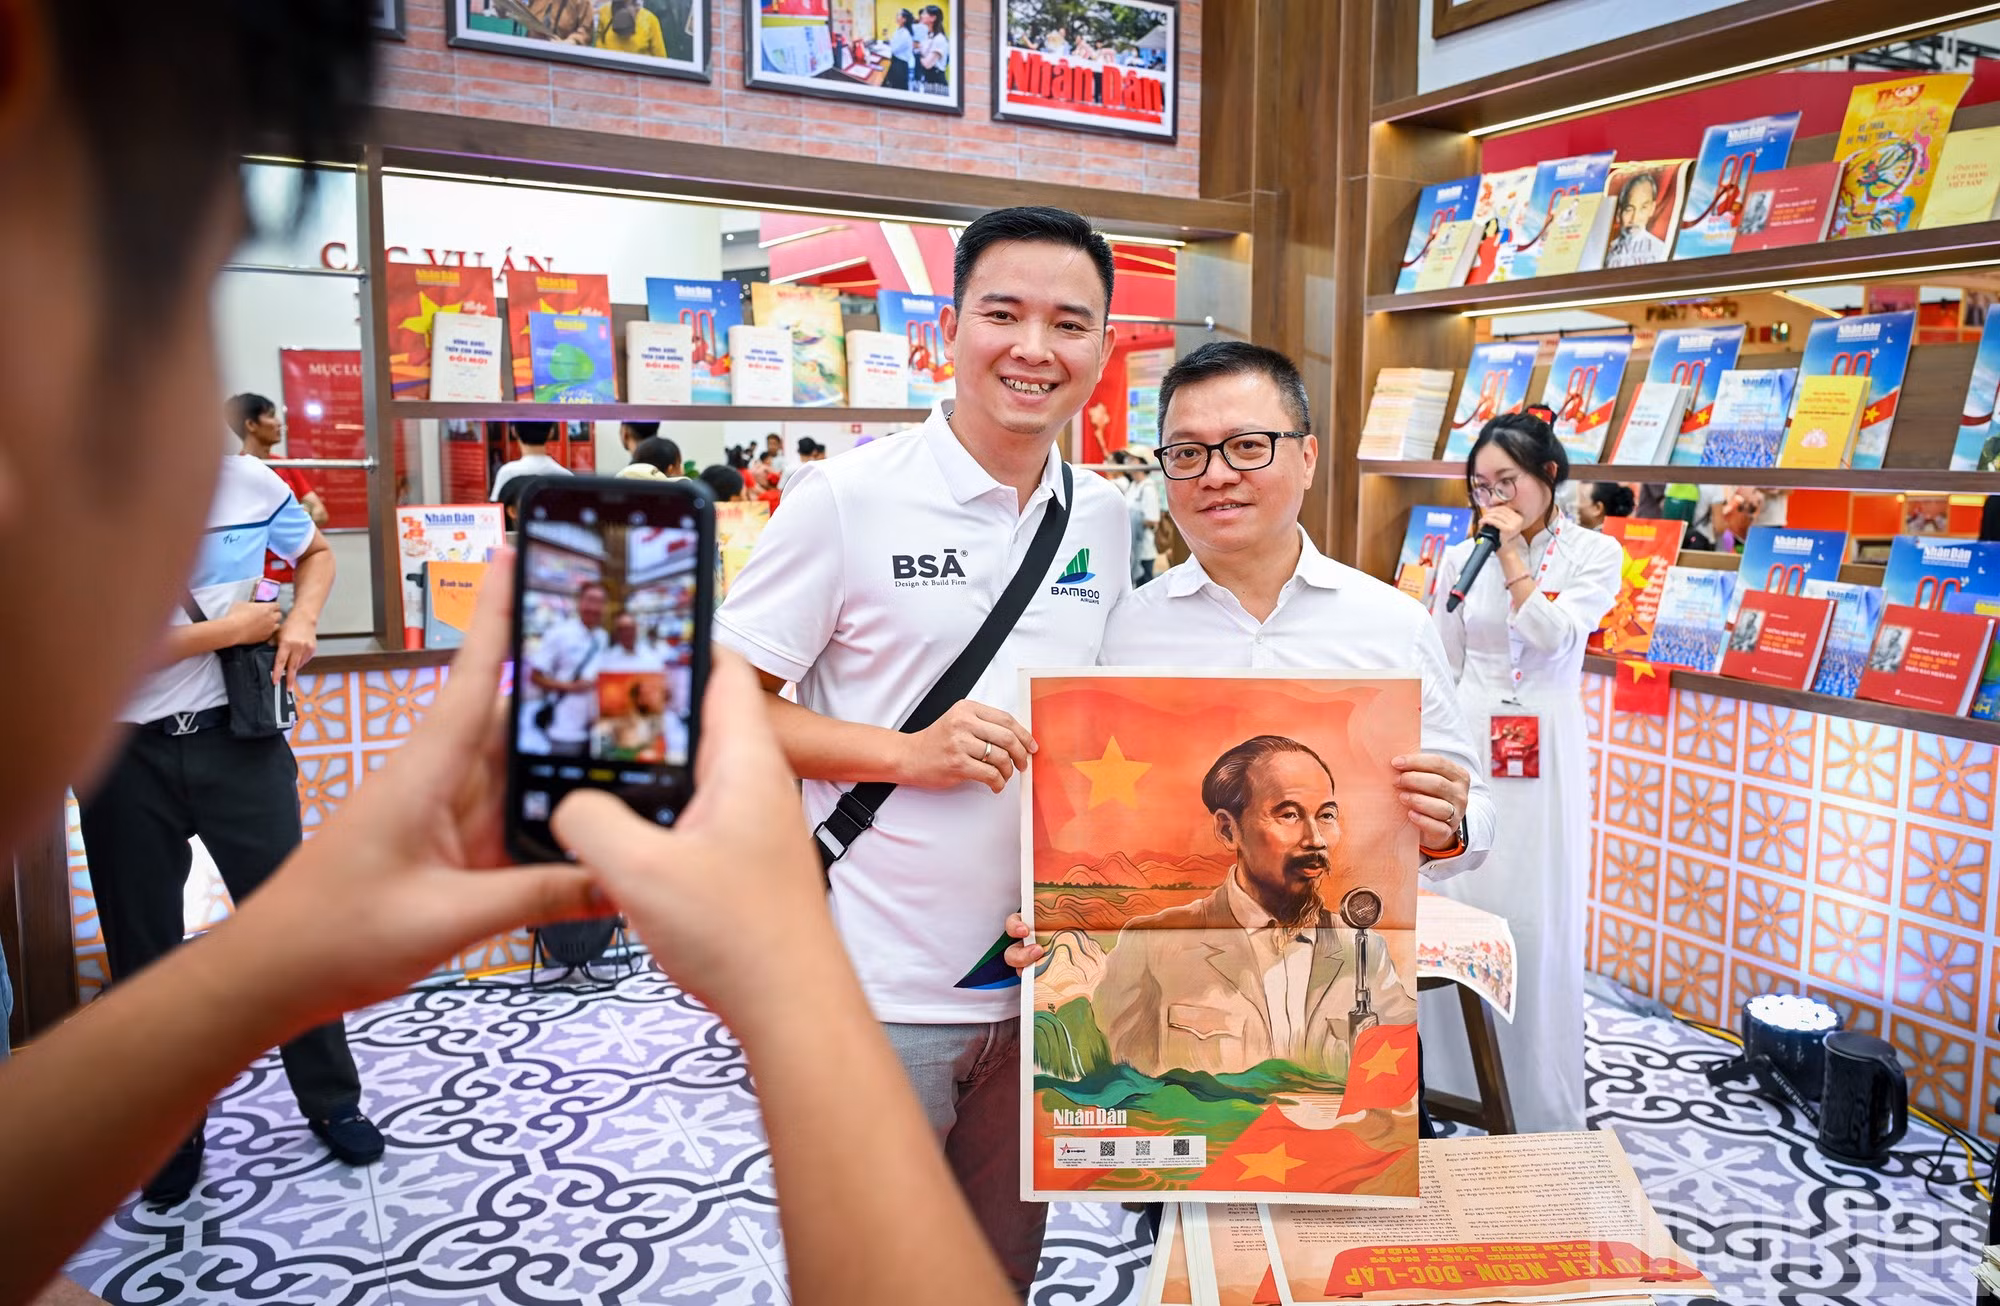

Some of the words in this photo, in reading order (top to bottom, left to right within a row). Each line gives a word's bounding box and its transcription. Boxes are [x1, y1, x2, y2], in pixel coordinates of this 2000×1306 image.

[1007, 50, 1095, 102] Nhân
[1102, 65, 1163, 112] Dân
[425, 512, 453, 523] Nhân
[454, 512, 475, 523] Dân
[1051, 586, 1099, 599] BAMBOO
[1054, 1108, 1095, 1125] Nhân
[1096, 1108, 1127, 1125] Dân
[1425, 1246, 1484, 1255] CỘNG
[1491, 1244, 1537, 1255] CHỦ
[1543, 1243, 1591, 1252] DÂN
[1429, 1254, 1479, 1263] VIỆT
[1554, 1251, 1601, 1260] CỦA
[1345, 1264, 1464, 1286] ĐỘC-LẬP
